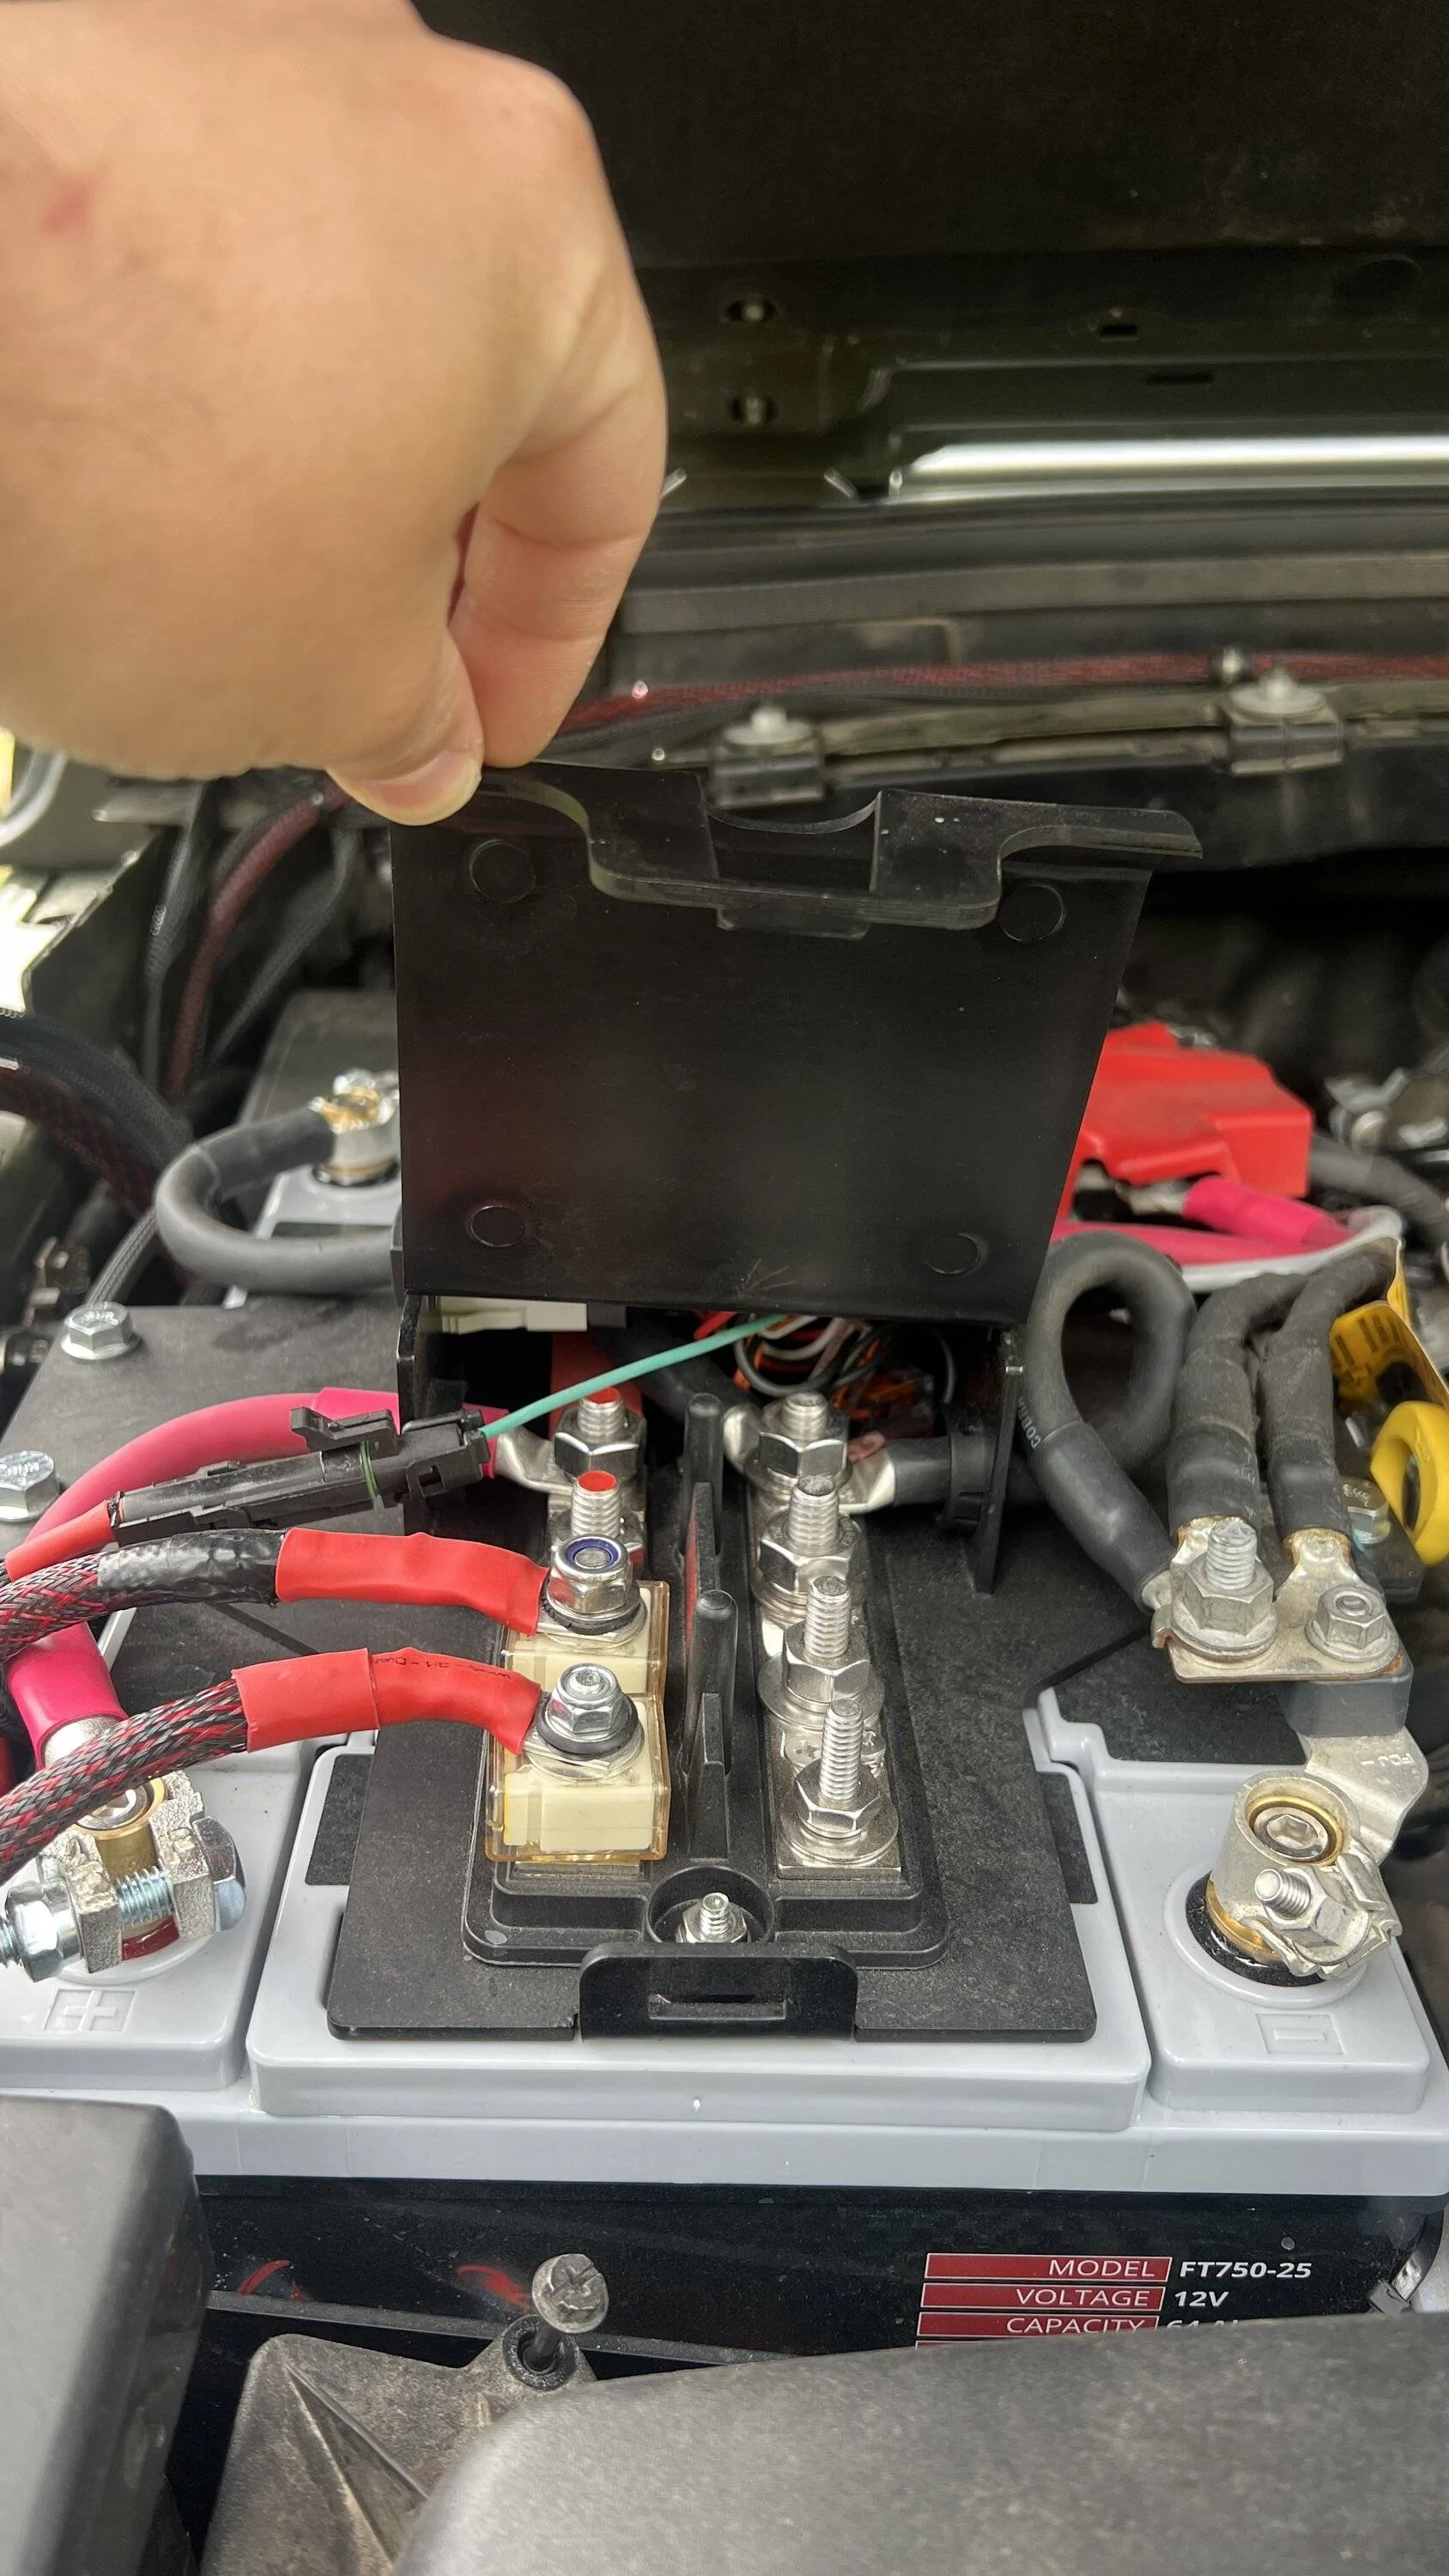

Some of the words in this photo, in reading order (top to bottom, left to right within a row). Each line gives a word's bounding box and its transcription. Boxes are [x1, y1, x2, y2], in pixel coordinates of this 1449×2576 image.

[1049, 2259, 1155, 2277] MODEL
[1179, 2261, 1313, 2279] FT750-25
[1016, 2288, 1150, 2306] VOLTAGE
[1174, 2291, 1229, 2307] 12V
[1006, 2318, 1145, 2334] CAPACITY
